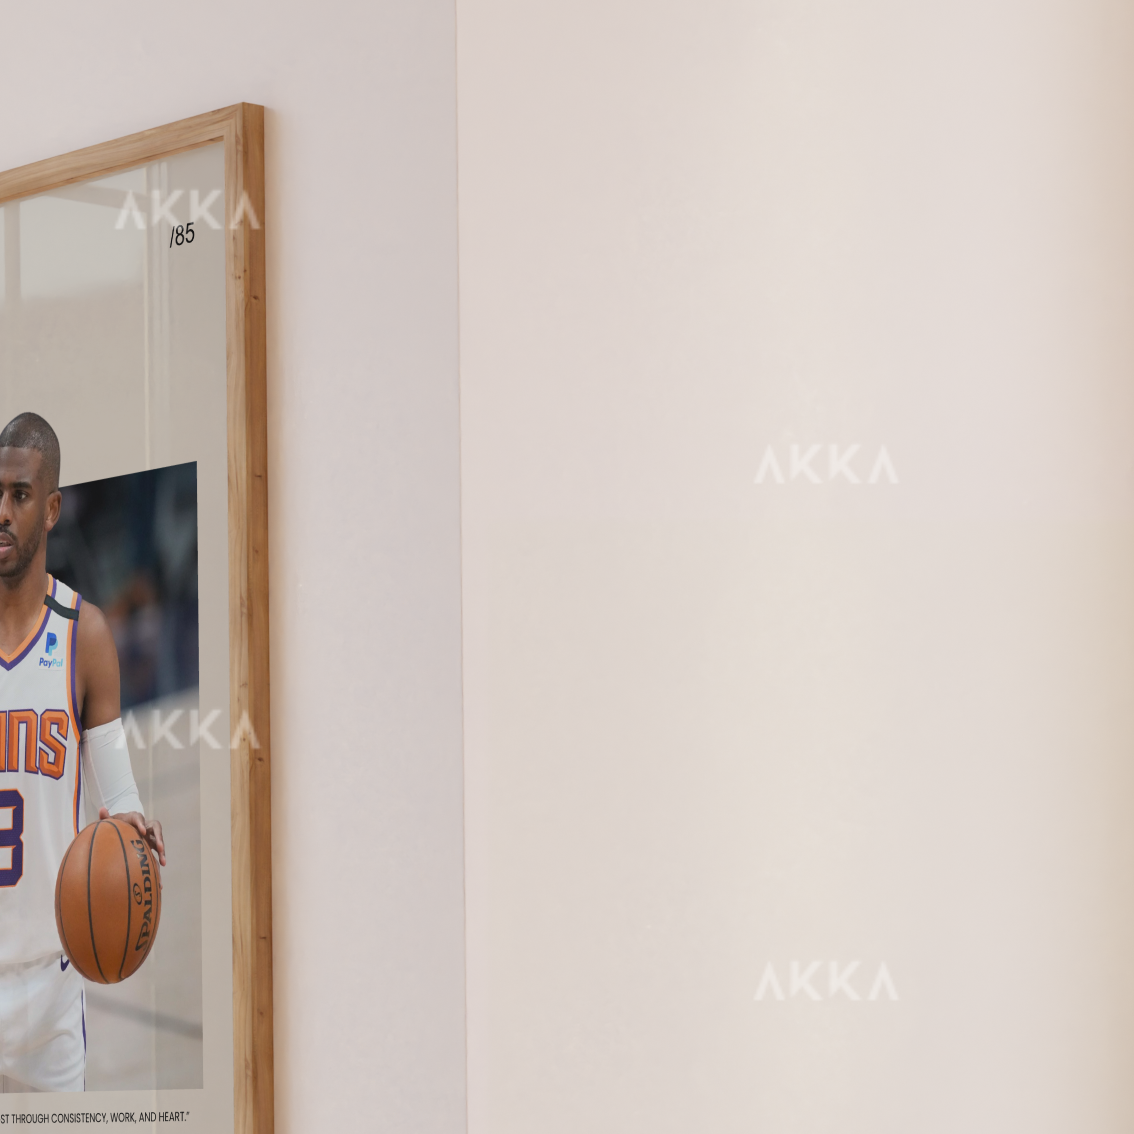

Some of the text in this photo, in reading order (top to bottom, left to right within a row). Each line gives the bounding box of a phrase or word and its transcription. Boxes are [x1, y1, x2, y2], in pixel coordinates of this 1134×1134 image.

[170, 222, 195, 248] /85
[39, 657, 63, 668] PayPal
[131, 839, 152, 951] SPALDING
[12, 1114, 49, 1124] THROUGH
[51, 1113, 108, 1124] CONSISTENCY,
[110, 1112, 136, 1124] WORK,
[139, 1112, 156, 1122] AND
[159, 1112, 190, 1122] HEART."
